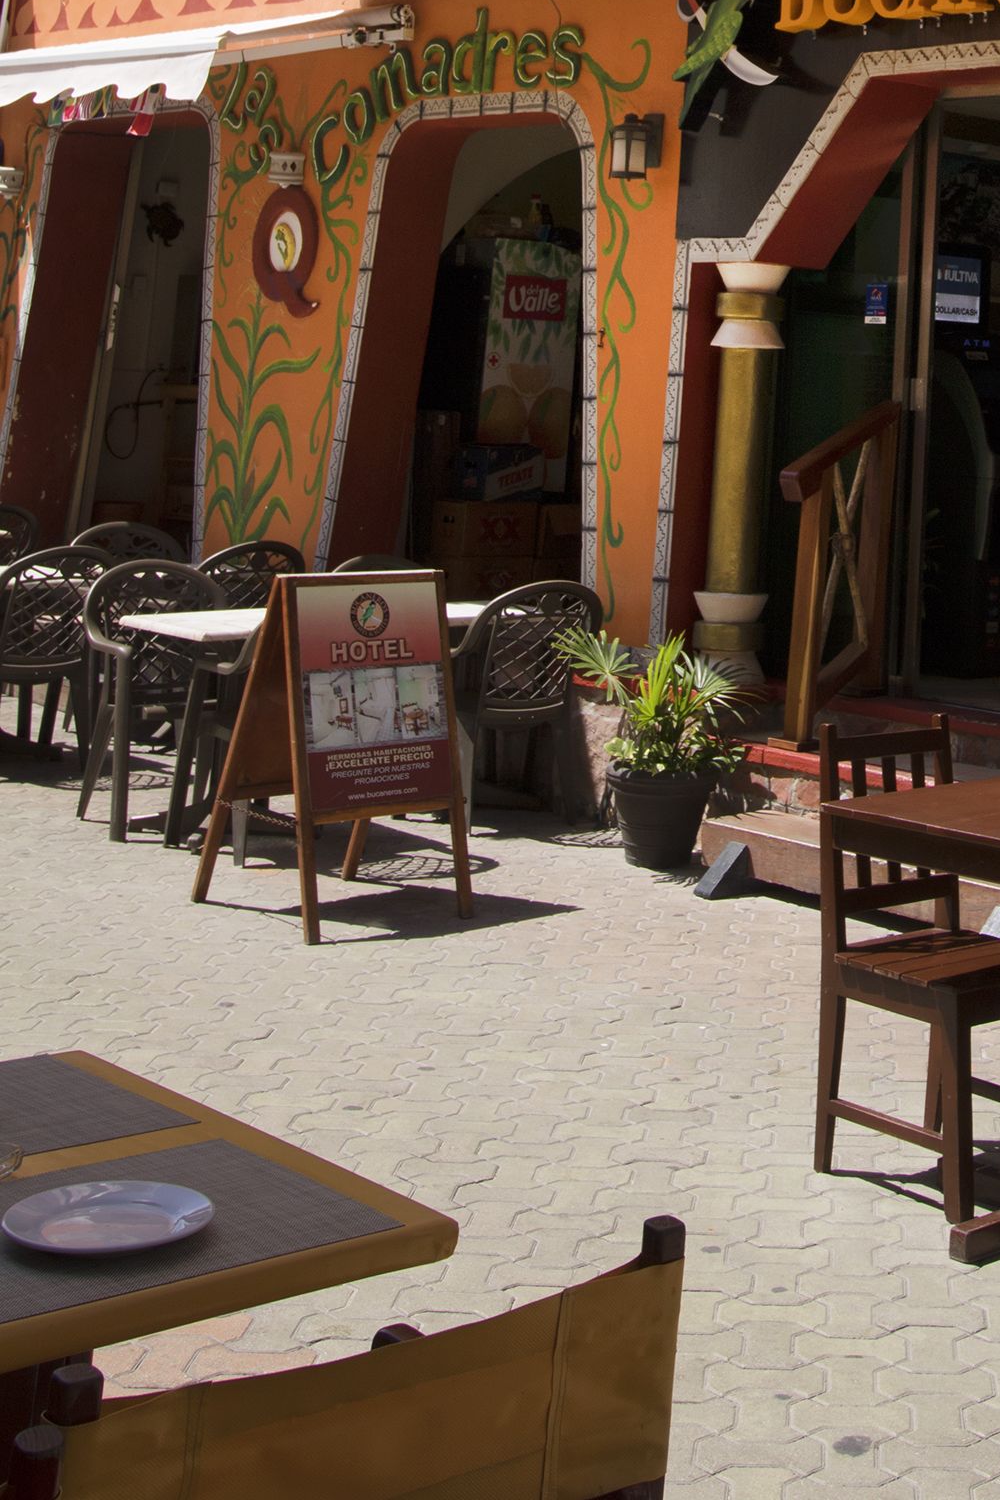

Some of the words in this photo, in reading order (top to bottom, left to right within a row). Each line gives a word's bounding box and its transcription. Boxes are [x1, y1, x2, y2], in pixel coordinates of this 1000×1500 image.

[937, 267, 979, 284] MULTIVA
[509, 285, 560, 313] Valle
[330, 638, 414, 663] HOTEL
[325, 755, 391, 772] ¡EXCELENTE
[393, 751, 434, 763] PRECIO!
[327, 750, 372, 762] HERMOSAS
[373, 744, 432, 757] HABITACIONES
[331, 768, 373, 779] PREGUNTE
[374, 766, 390, 775] POR
[391, 761, 431, 773] NUESTRAS
[354, 772, 410, 785] PROMOCIONES
